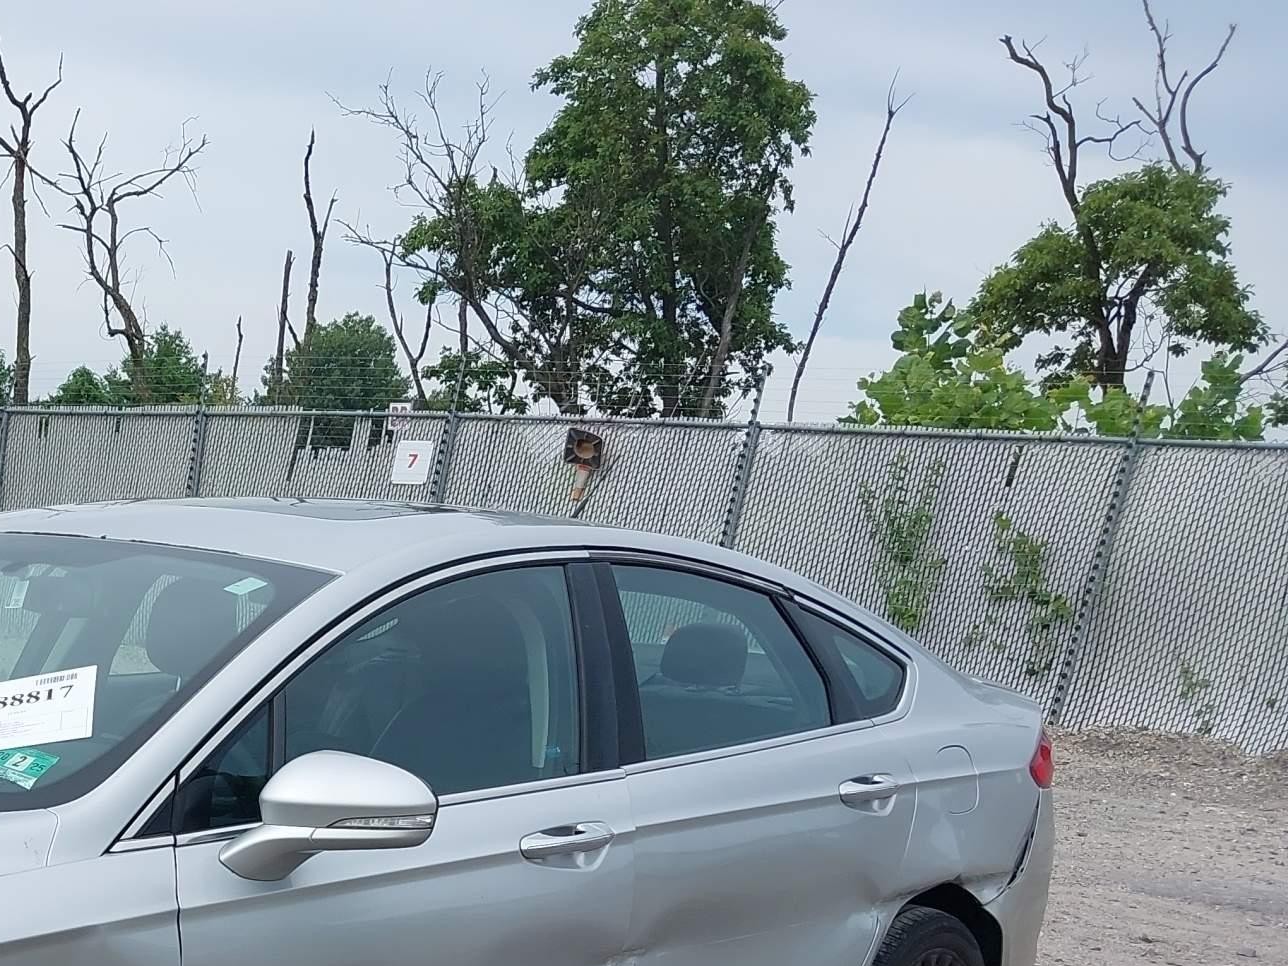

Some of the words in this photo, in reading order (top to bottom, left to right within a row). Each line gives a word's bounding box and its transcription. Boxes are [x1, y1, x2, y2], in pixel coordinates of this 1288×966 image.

[407, 453, 419, 469] 7
[12, 755, 28, 768] 2
[30, 762, 46, 772] 25
